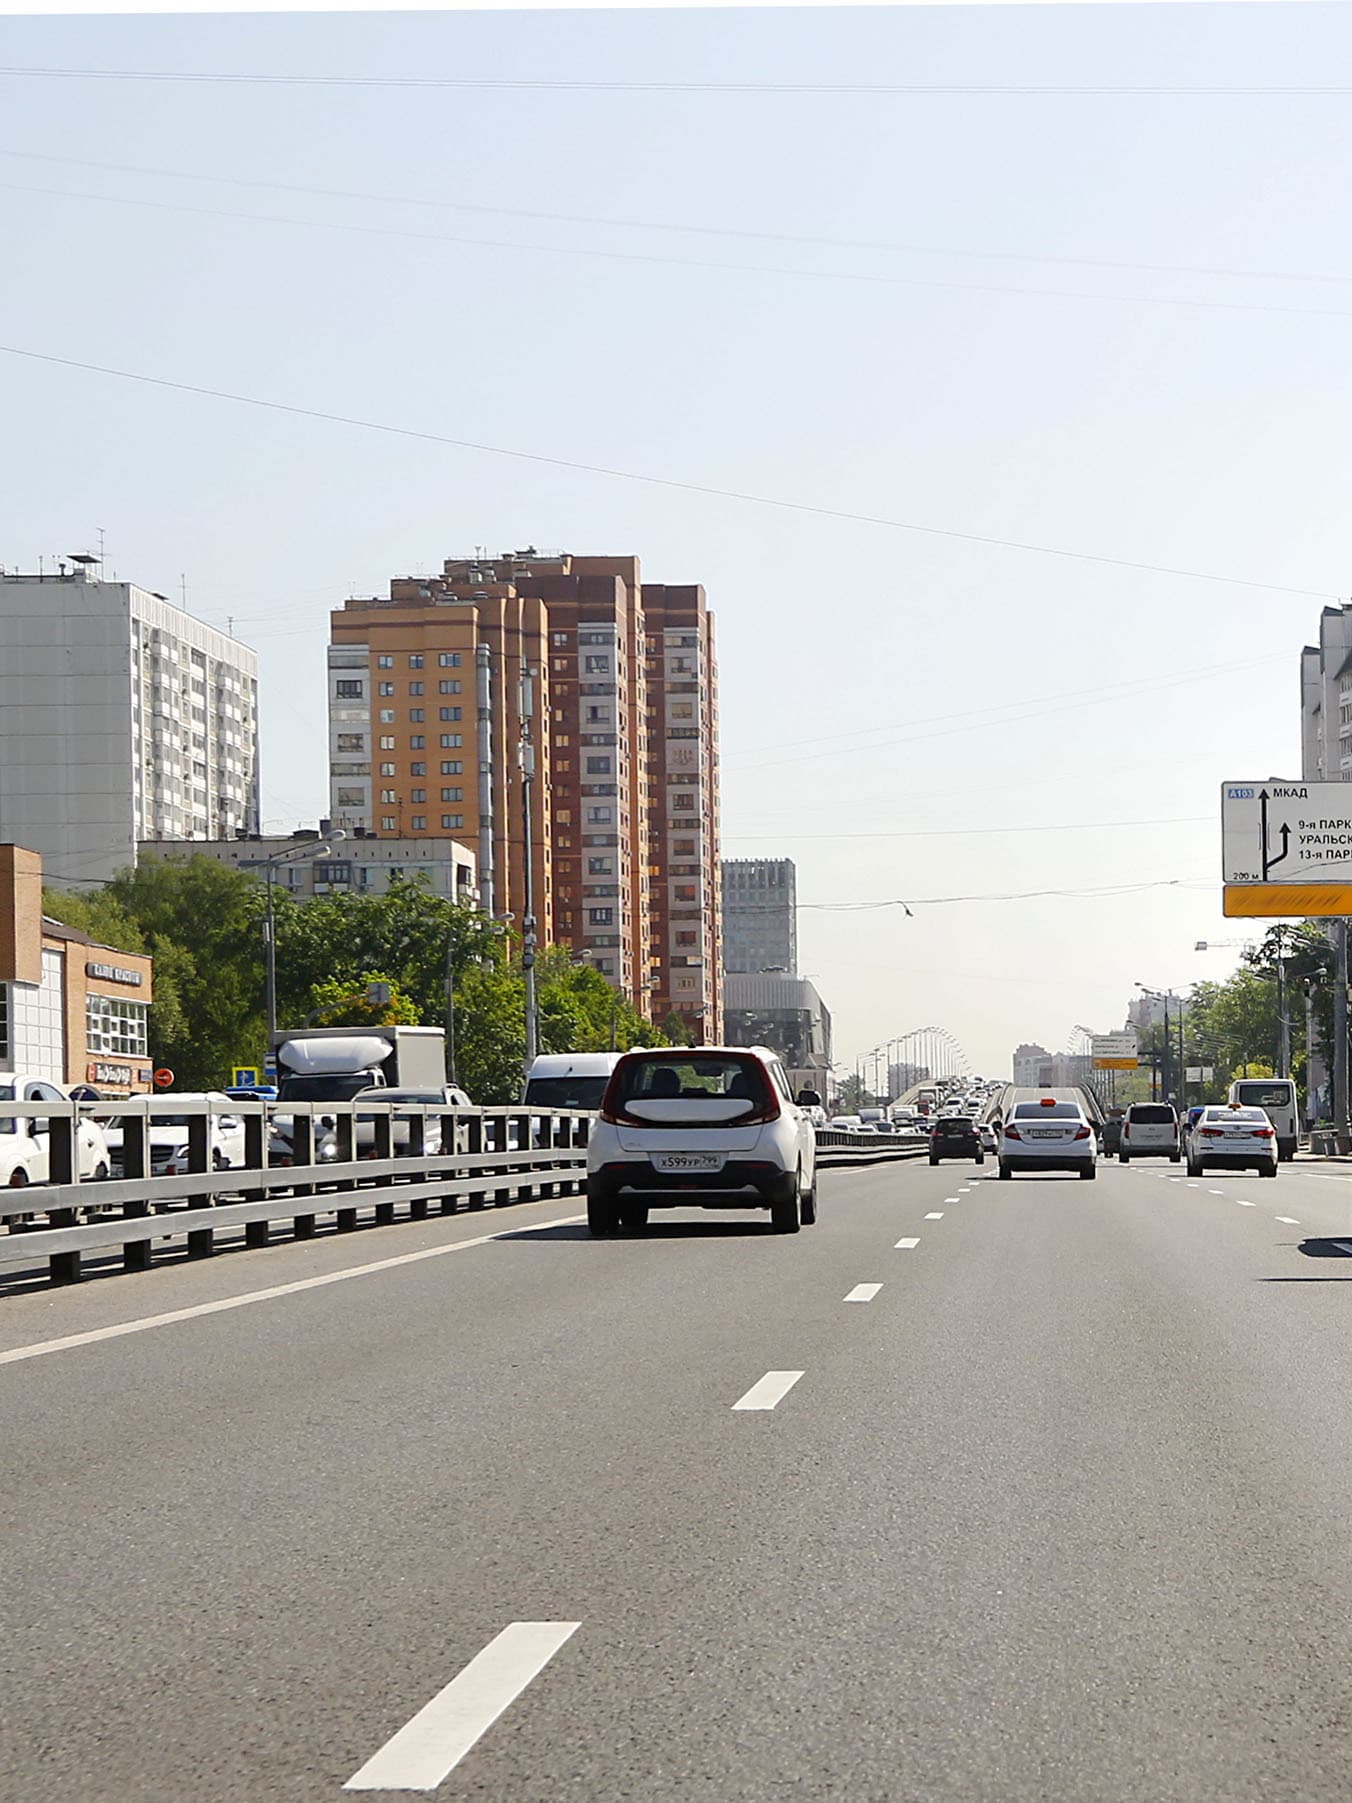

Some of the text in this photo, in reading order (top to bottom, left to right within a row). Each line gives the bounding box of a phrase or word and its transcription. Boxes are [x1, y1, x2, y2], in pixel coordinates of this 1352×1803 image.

[1273, 788, 1308, 798] МКАД
[1298, 820, 1316, 829] 9-я
[1299, 850, 1322, 859] 13-я
